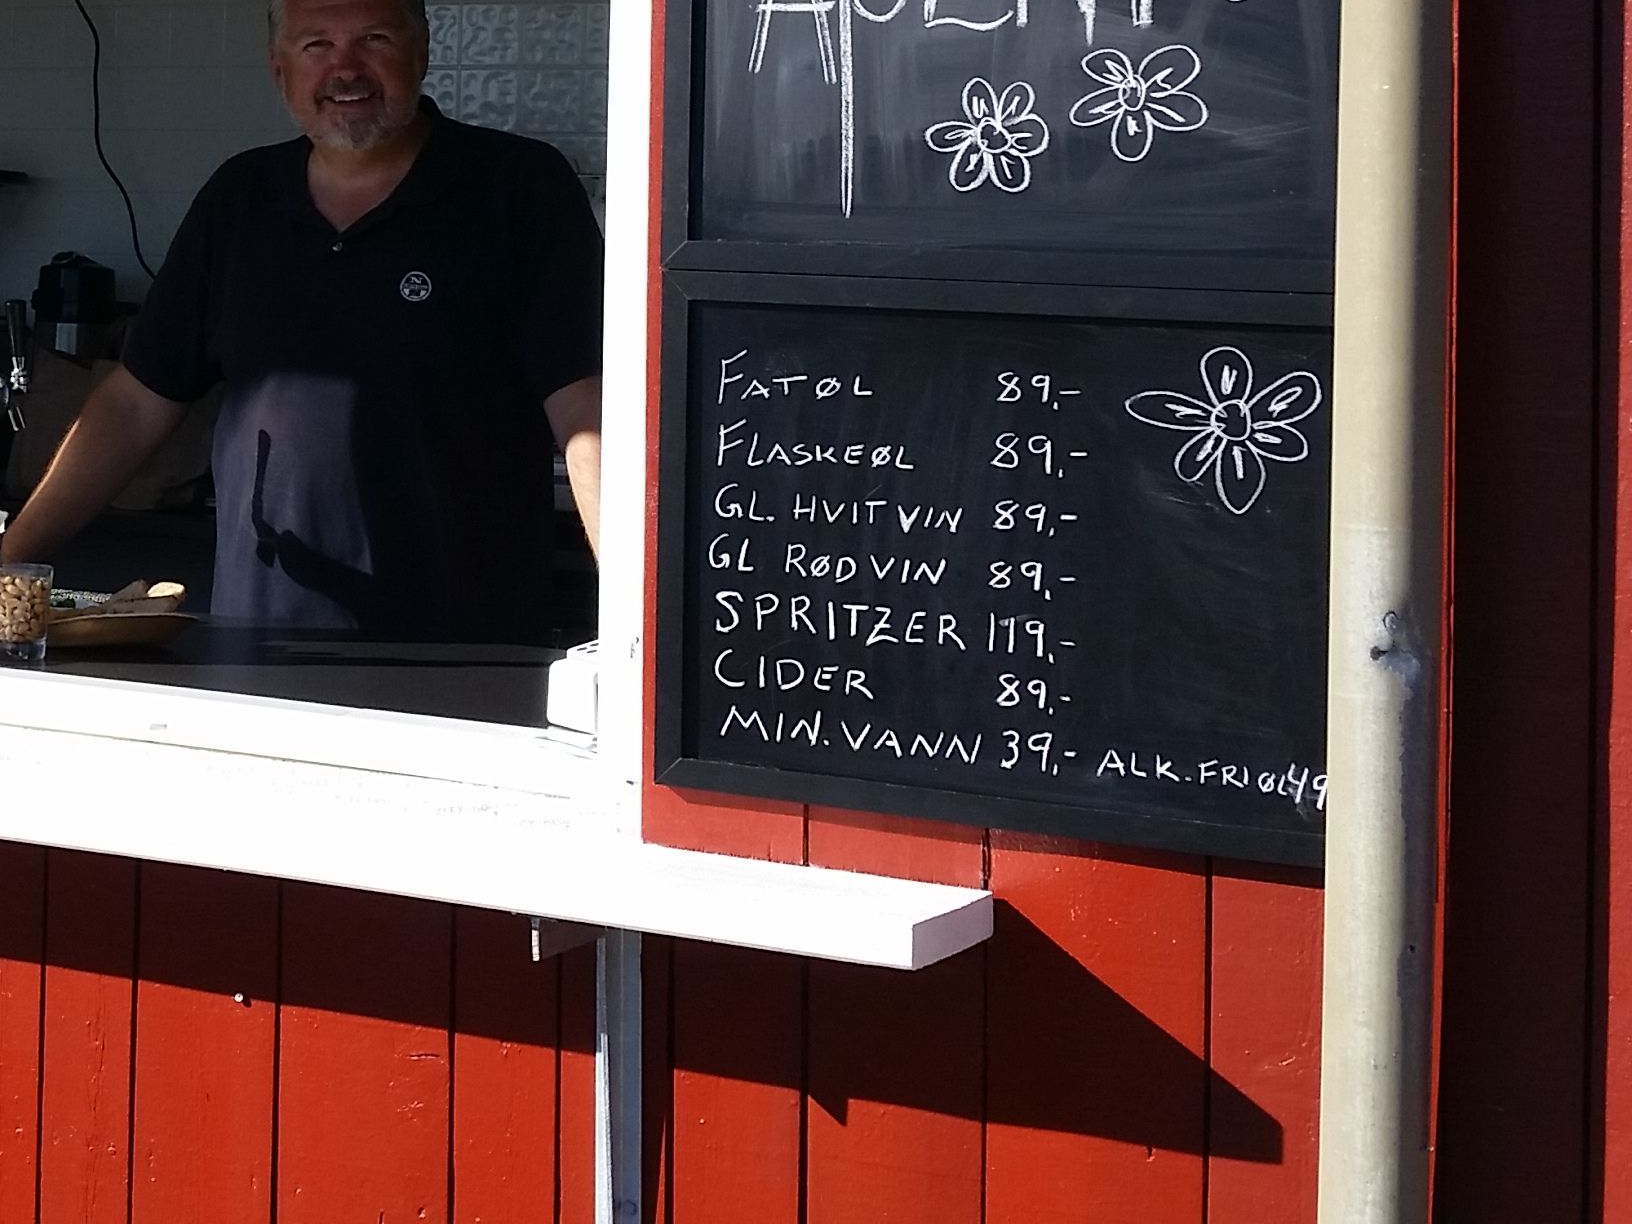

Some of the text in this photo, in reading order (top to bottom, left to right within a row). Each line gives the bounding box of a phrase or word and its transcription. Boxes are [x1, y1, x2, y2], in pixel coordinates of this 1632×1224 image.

[995, 371, 1082, 411] 89,-
[989, 432, 1089, 478] 89,-
[713, 482, 775, 523] GL.
[992, 499, 1079, 537] 89,-
[708, 533, 755, 573] GL
[988, 560, 1077, 601] 89,-
[714, 590, 967, 651] SPRITZER
[713, 648, 1072, 715] CIDER 89,-
[999, 729, 1078, 776] 39,-
